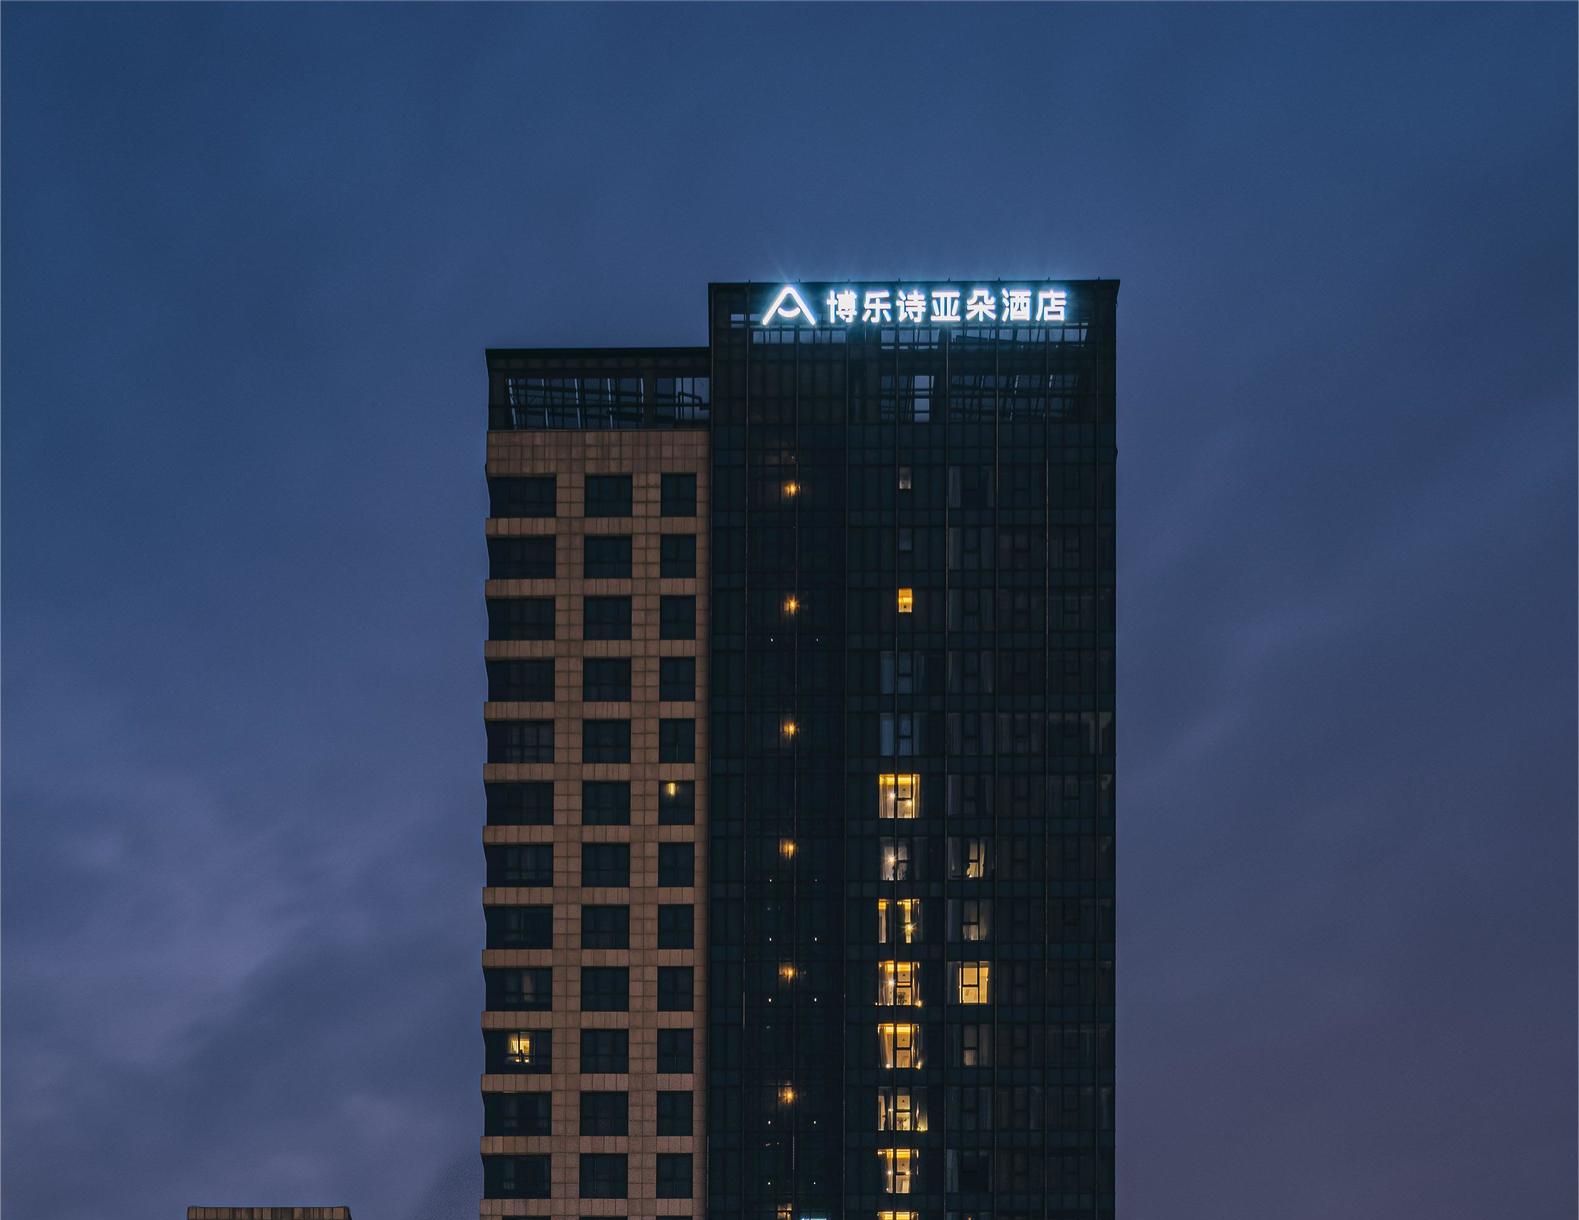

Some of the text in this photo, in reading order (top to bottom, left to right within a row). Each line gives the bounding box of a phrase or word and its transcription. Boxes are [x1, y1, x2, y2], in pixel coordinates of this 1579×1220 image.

[827, 288, 1067, 323] 博乐诗亚朵酒店
